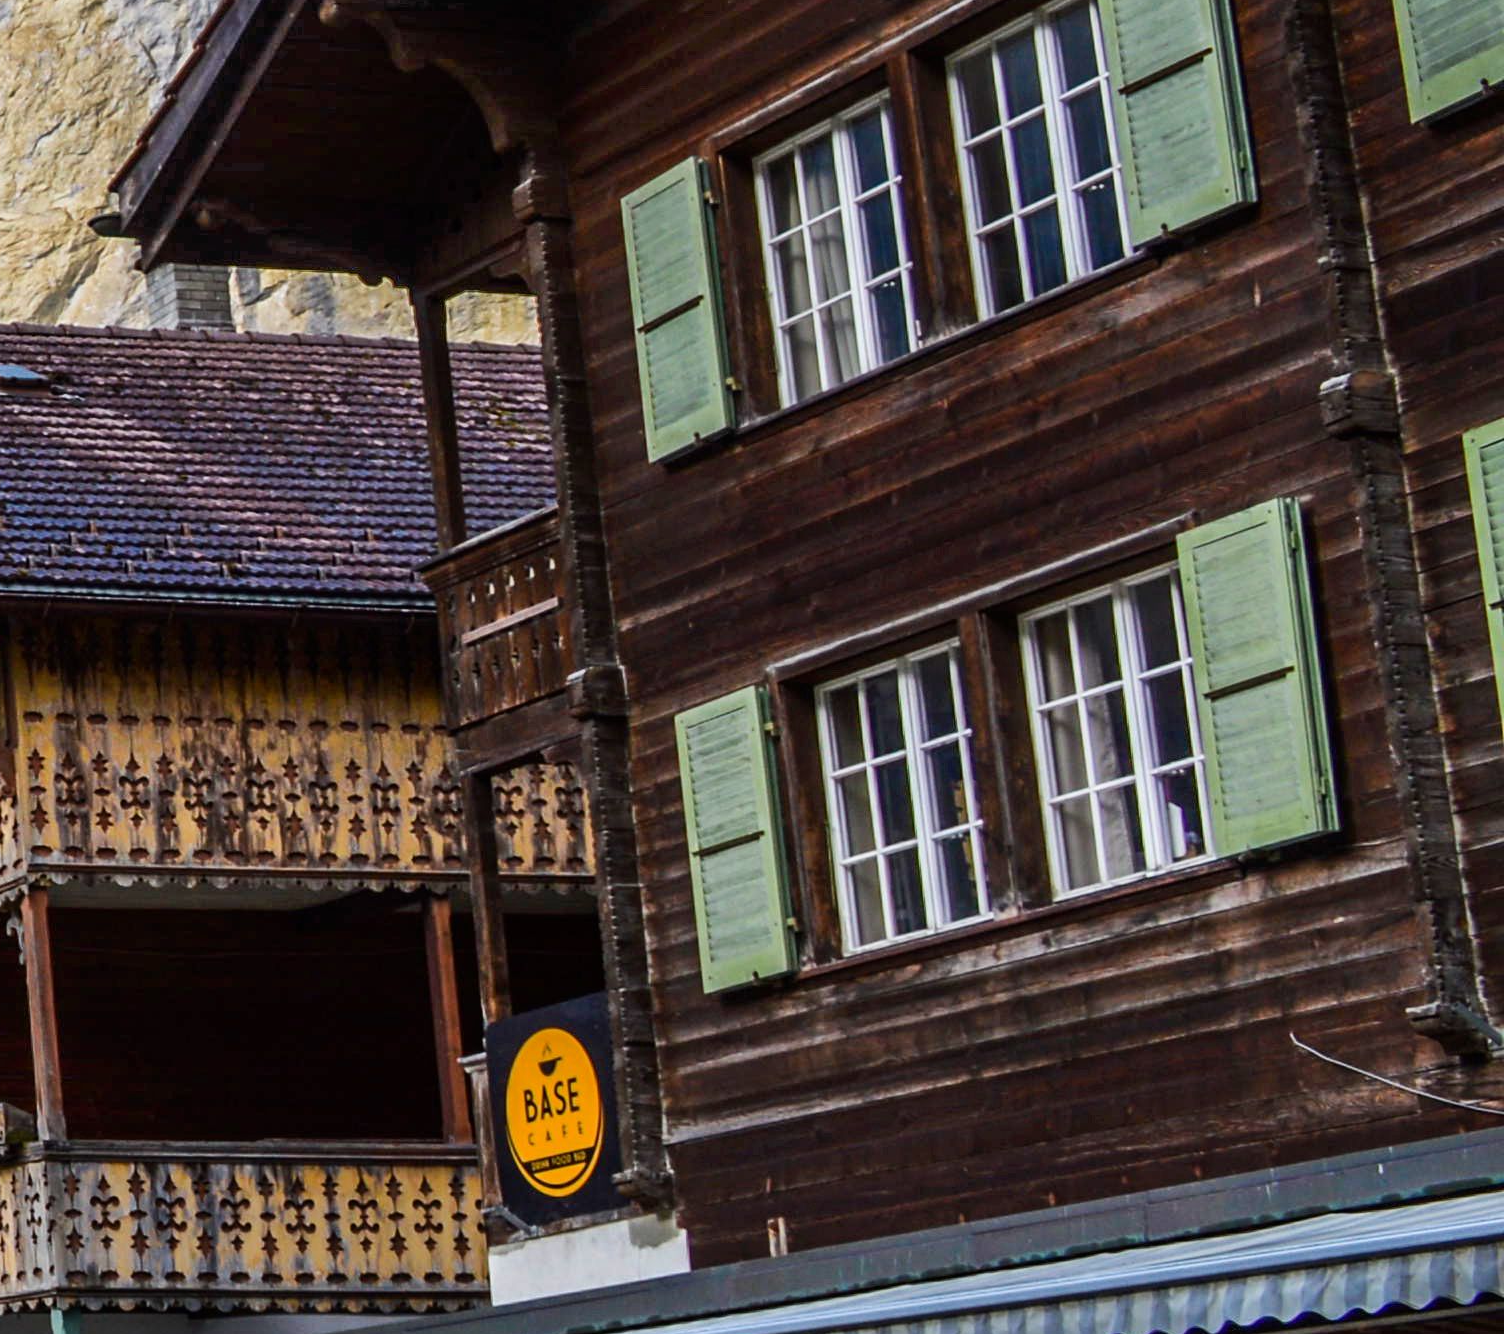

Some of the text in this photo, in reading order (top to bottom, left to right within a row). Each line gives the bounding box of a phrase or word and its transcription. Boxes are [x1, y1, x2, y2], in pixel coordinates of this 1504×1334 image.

[523, 1078, 581, 1123] BASE
[528, 1121, 584, 1146] CAFE
[551, 1154, 571, 1166] FOOD
